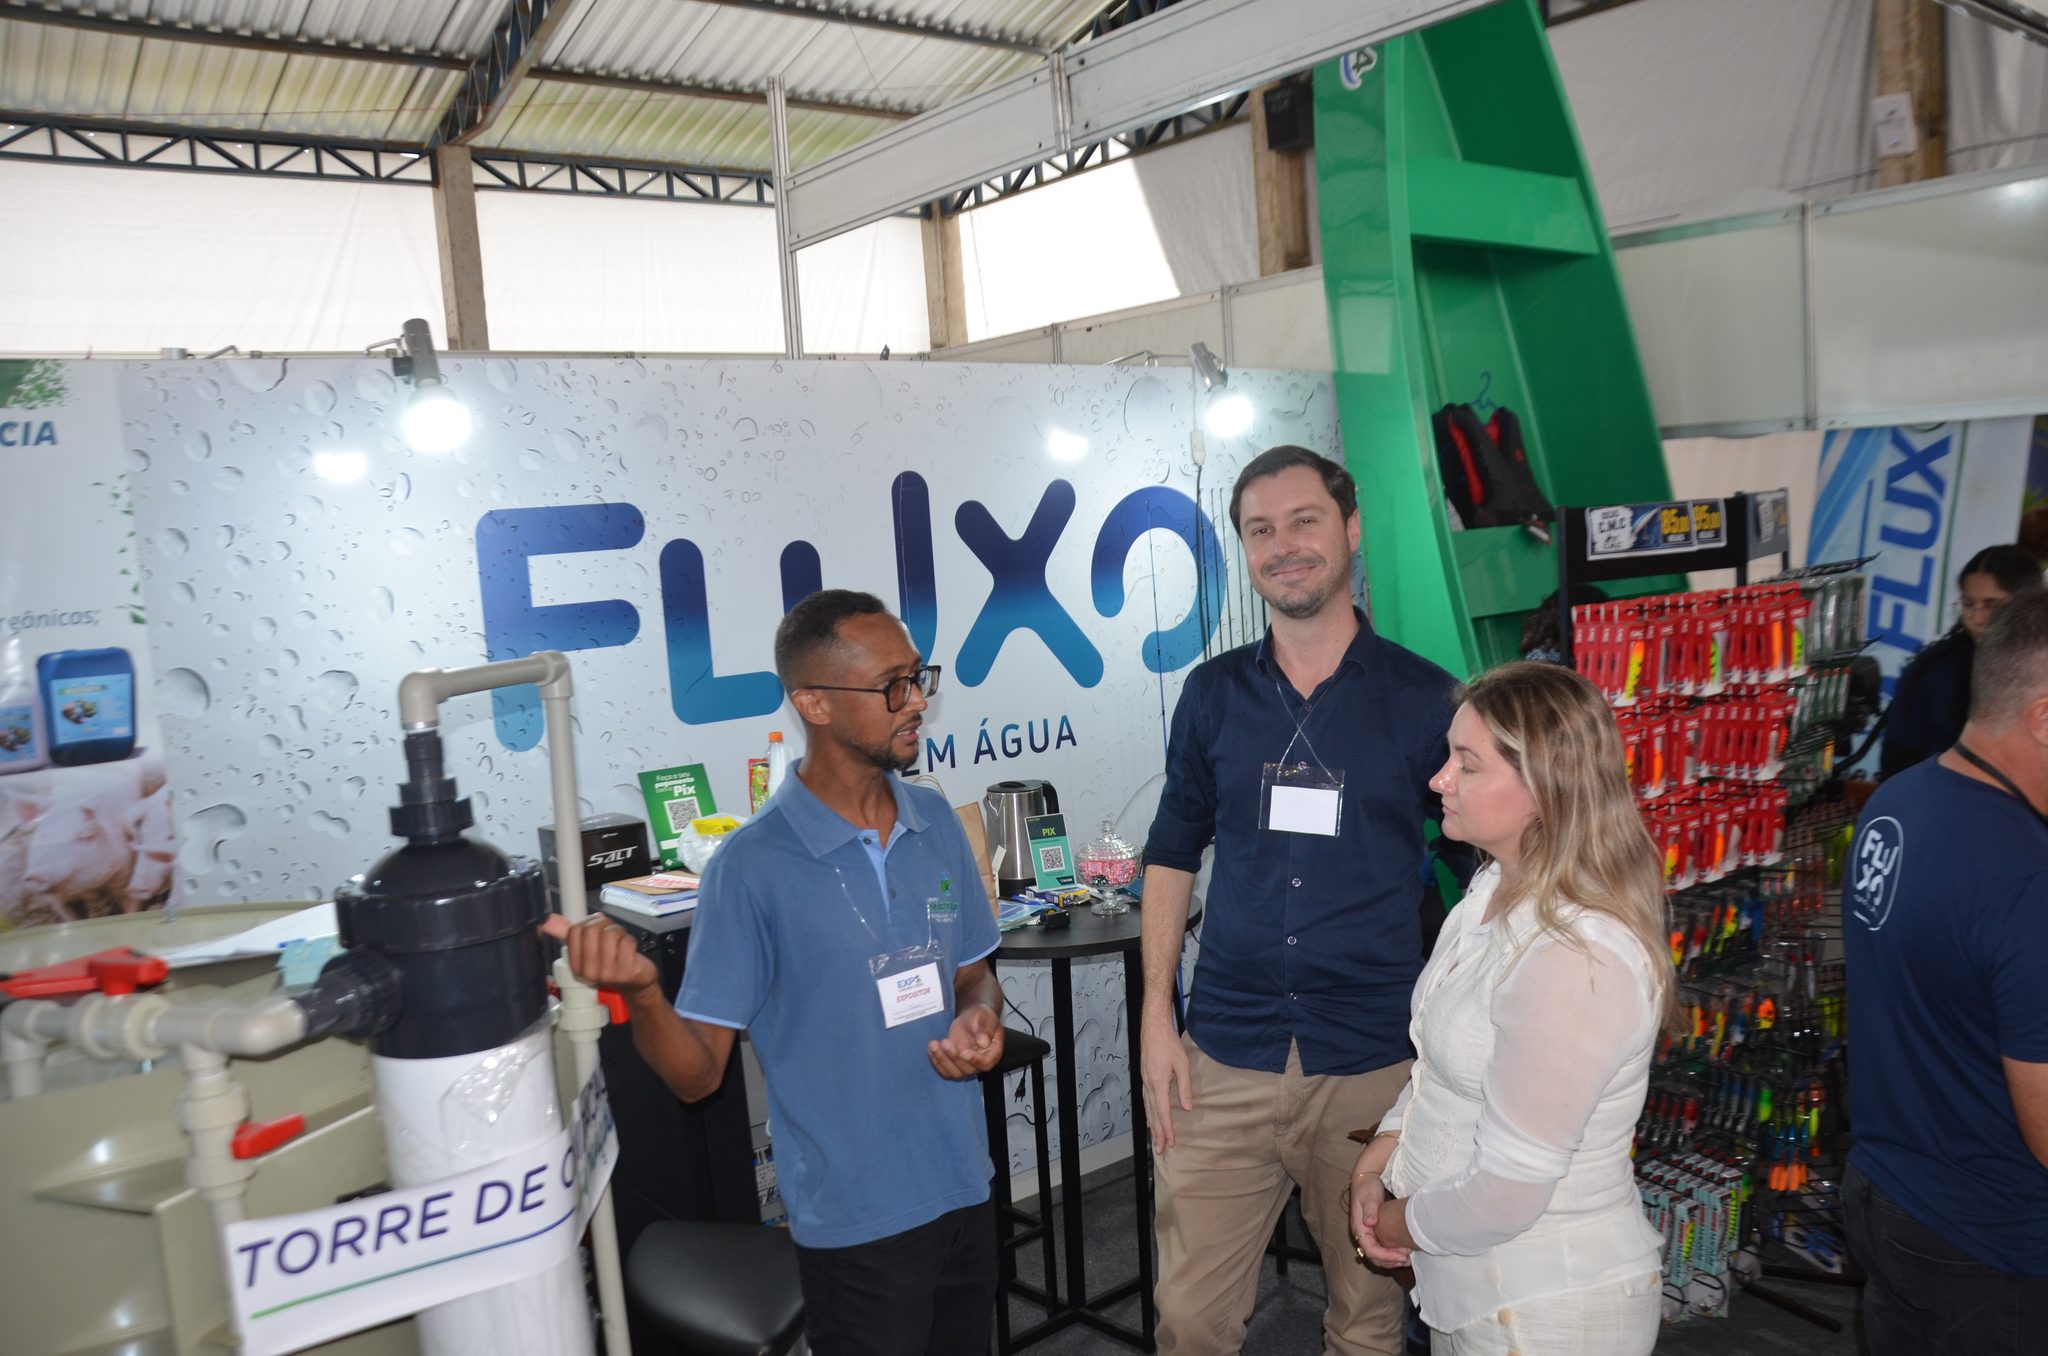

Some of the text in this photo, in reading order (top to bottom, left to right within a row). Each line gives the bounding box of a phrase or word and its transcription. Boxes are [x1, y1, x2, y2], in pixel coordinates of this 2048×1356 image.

[901, 715, 1077, 777] M ÁGUA
[673, 783, 696, 797] Pix
[1042, 827, 1056, 837] PIX
[587, 845, 634, 868] SALT
[236, 1164, 548, 1289] TORRE DE
